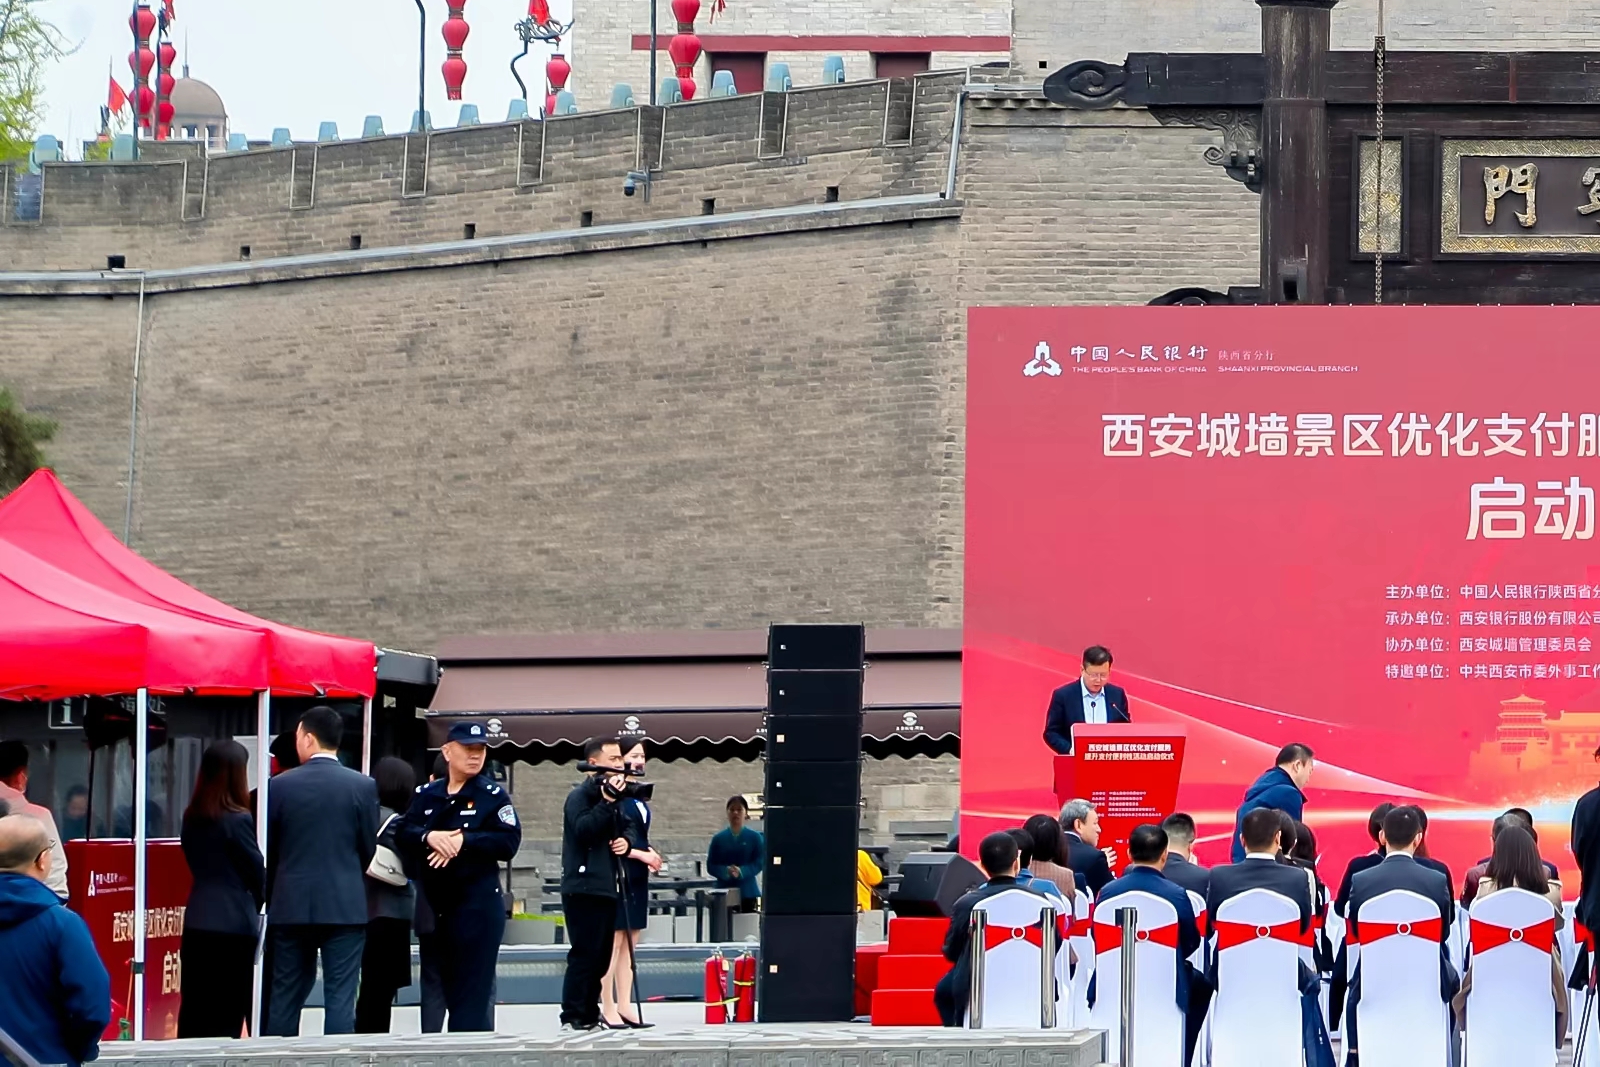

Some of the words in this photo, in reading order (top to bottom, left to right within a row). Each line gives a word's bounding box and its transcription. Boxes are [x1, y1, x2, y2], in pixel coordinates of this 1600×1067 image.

[1218, 349, 1275, 361] 陕西省分行
[1072, 365, 1090, 373] THE
[1091, 365, 1136, 373] PEOPLE'S
[1137, 365, 1163, 373] BANK
[1164, 365, 1177, 373] OF
[1178, 365, 1207, 373] CHINA
[1217, 365, 1259, 373] SHAANXI
[1260, 365, 1317, 373] PROVINCIAL
[1318, 365, 1359, 373] BRANCH
